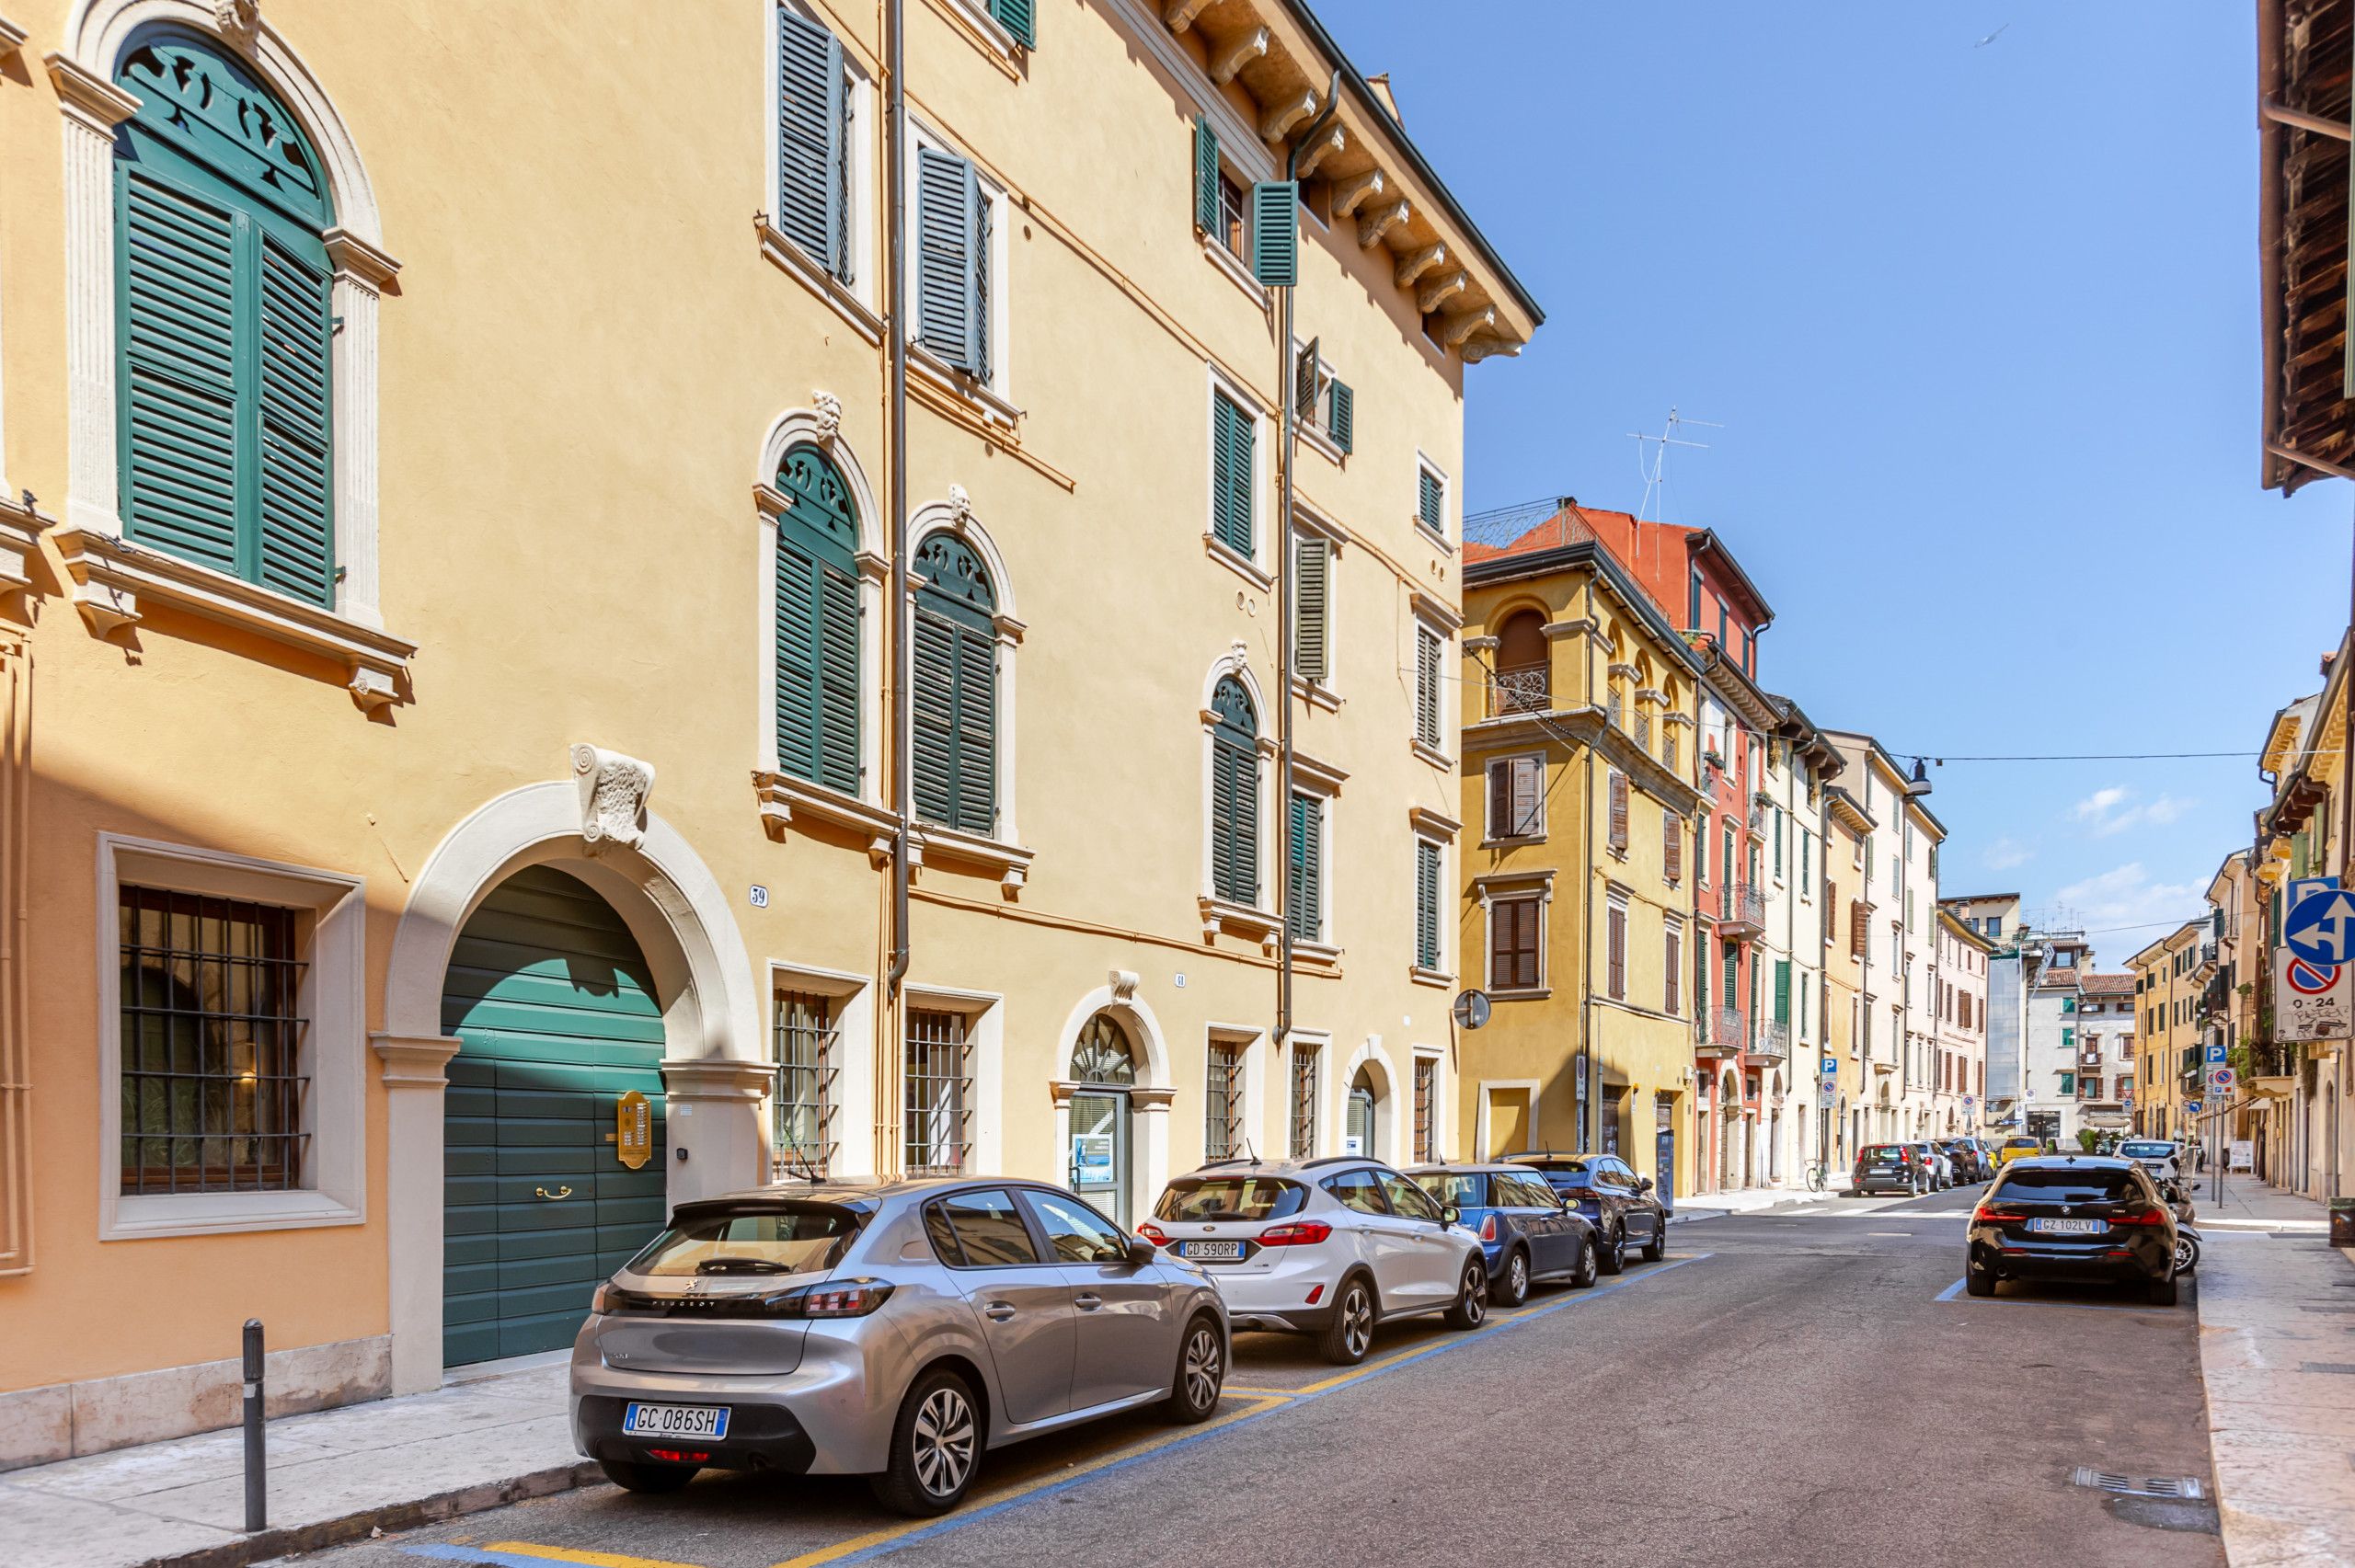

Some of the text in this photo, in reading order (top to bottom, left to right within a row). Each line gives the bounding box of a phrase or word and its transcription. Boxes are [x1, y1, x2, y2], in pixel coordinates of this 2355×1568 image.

[2292, 999, 2303, 1008] 0
[2315, 997, 2335, 1007] 24
[2210, 1047, 2223, 1061] P
[1824, 1059, 1834, 1071] P
[2061, 1220, 2091, 1230] 102LV
[1187, 1243, 1237, 1256] GD 590RP
[638, 1408, 659, 1428] GC
[662, 1409, 717, 1432] 086SH
